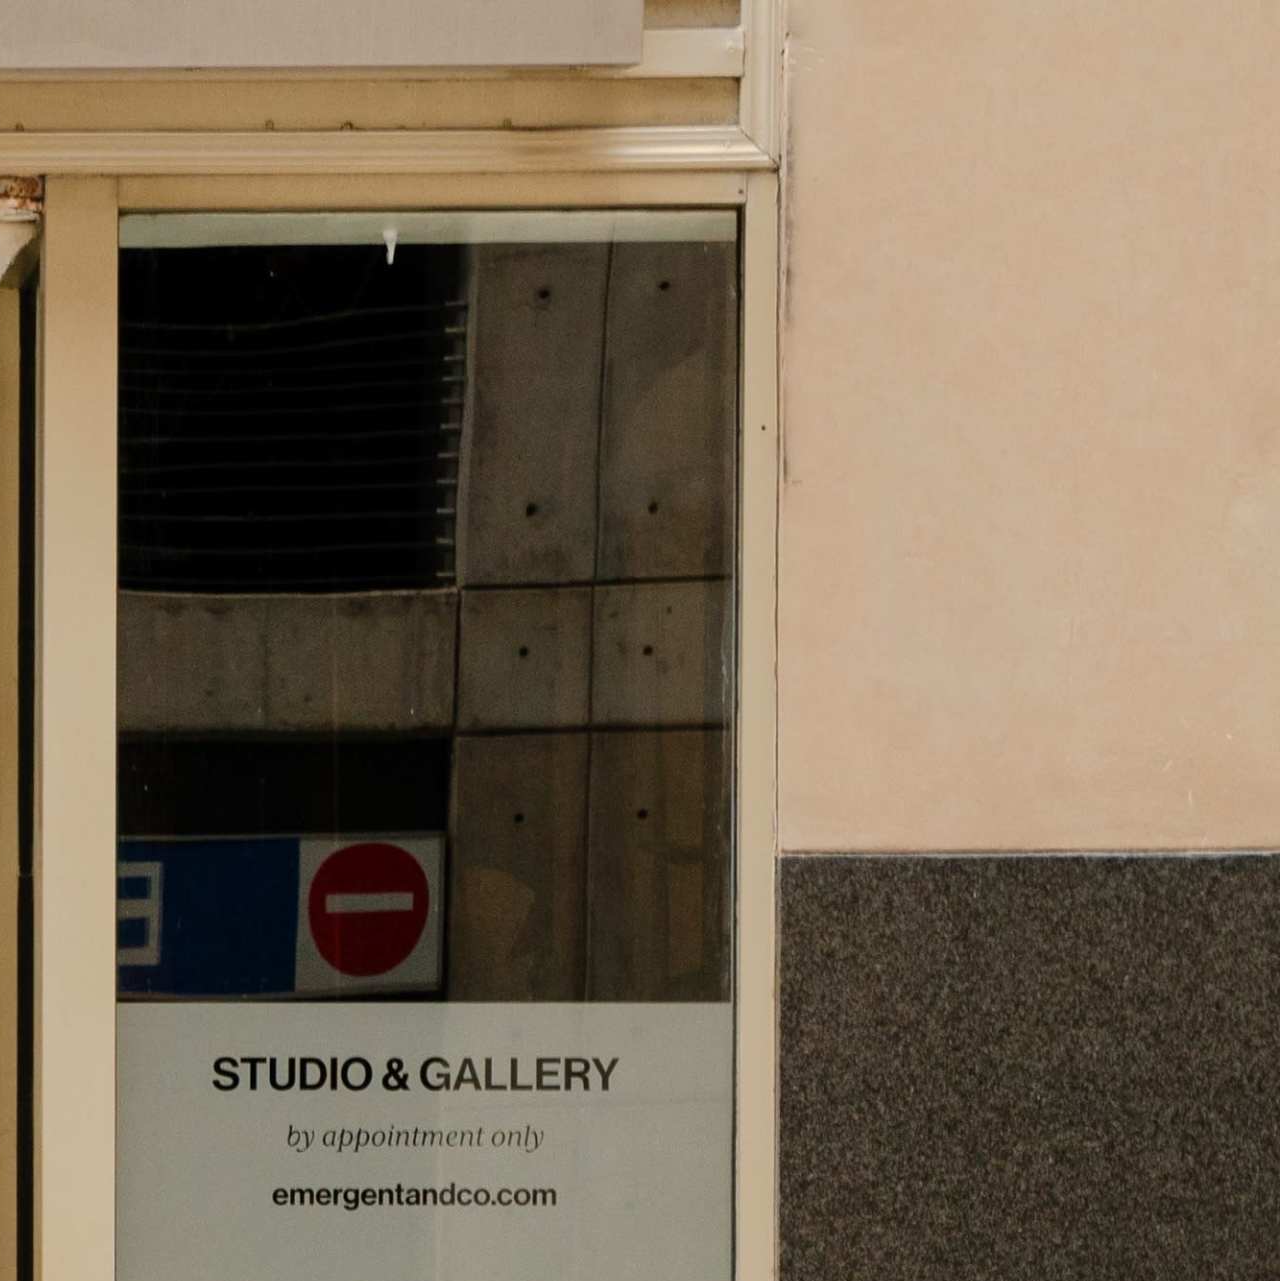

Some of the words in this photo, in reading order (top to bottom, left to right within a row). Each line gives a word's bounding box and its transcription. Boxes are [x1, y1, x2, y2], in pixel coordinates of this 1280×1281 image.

[212, 1056, 373, 1092] STUDIO
[381, 1057, 409, 1091] &
[419, 1056, 619, 1092] GALLERY
[286, 1124, 316, 1154] by
[321, 1125, 483, 1154] appointment
[490, 1124, 545, 1154] only
[271, 1182, 557, 1211] emergentandco.com
